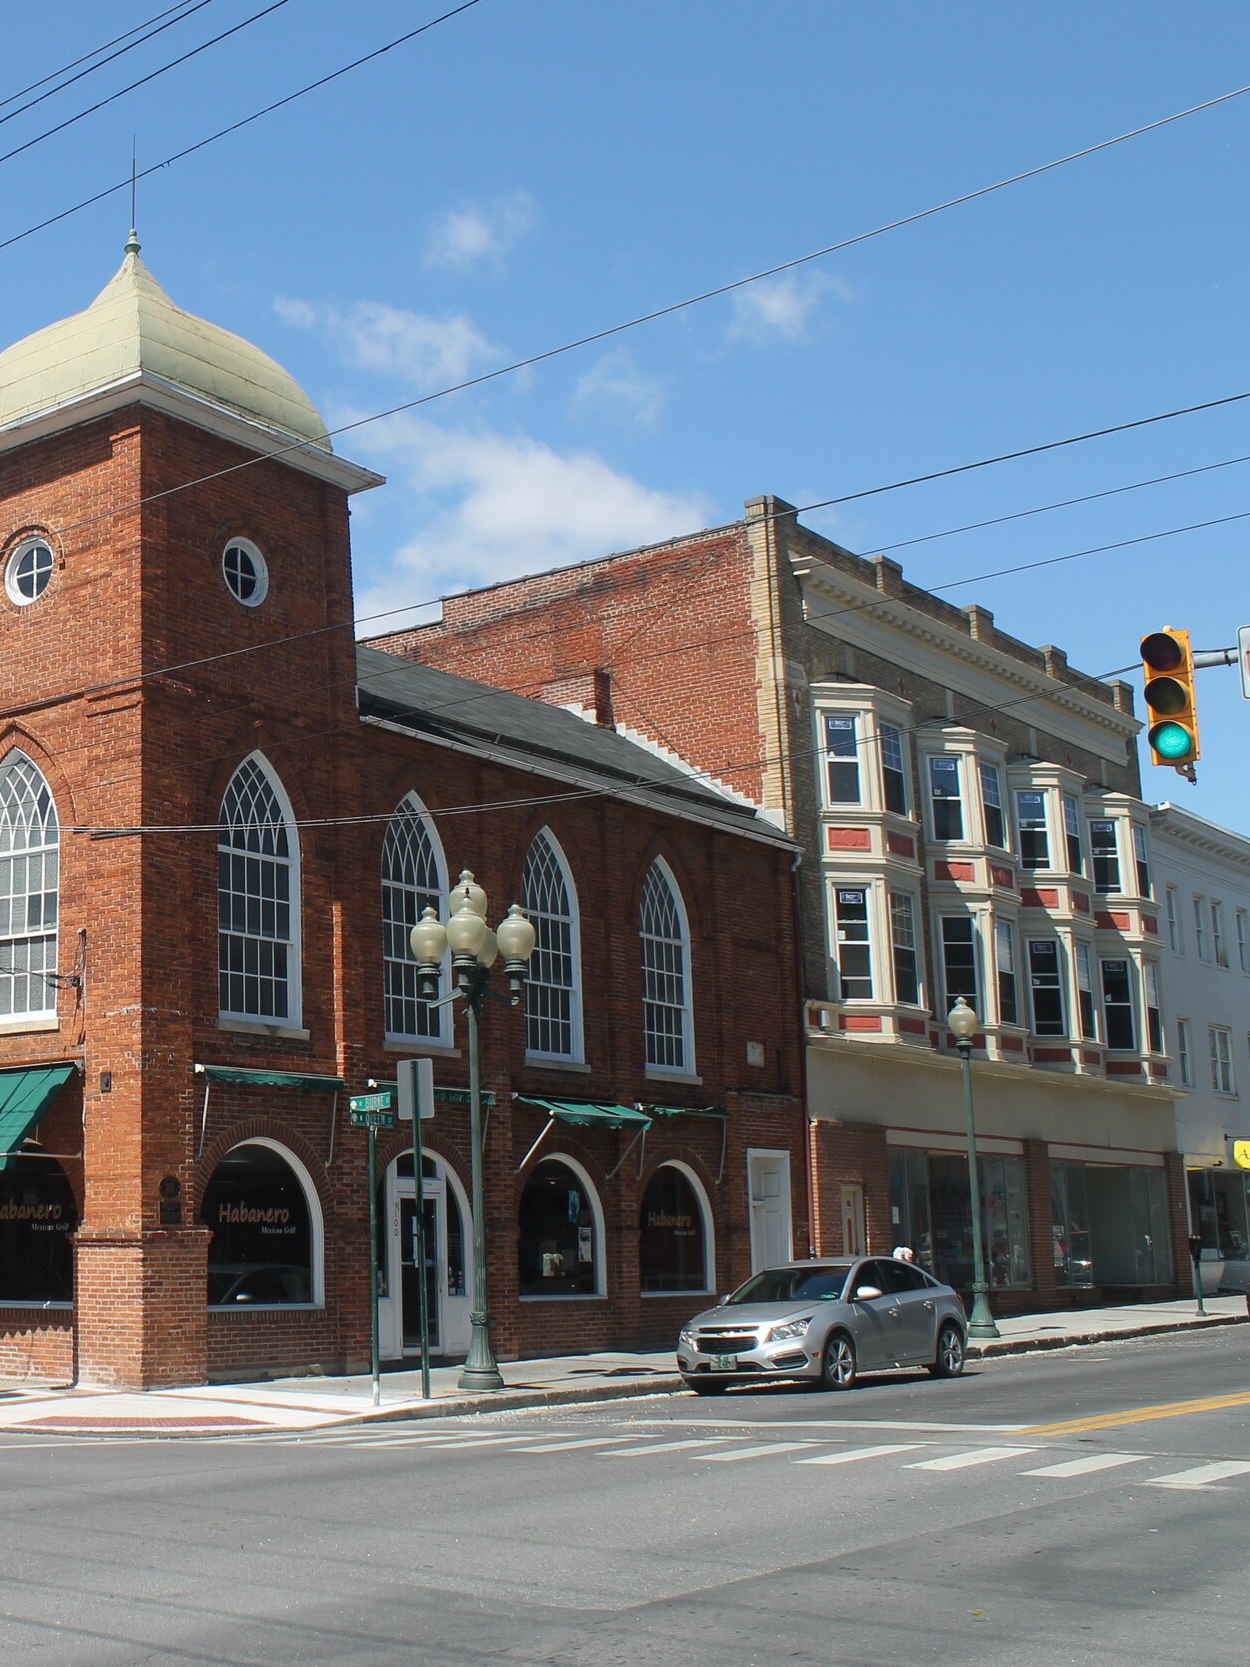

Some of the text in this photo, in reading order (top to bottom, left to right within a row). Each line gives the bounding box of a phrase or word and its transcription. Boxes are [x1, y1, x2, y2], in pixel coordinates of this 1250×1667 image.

[365, 1095, 384, 1109] BURKE
[218, 1200, 290, 1223] Habanero
[55, 1223, 70, 1231] Grill
